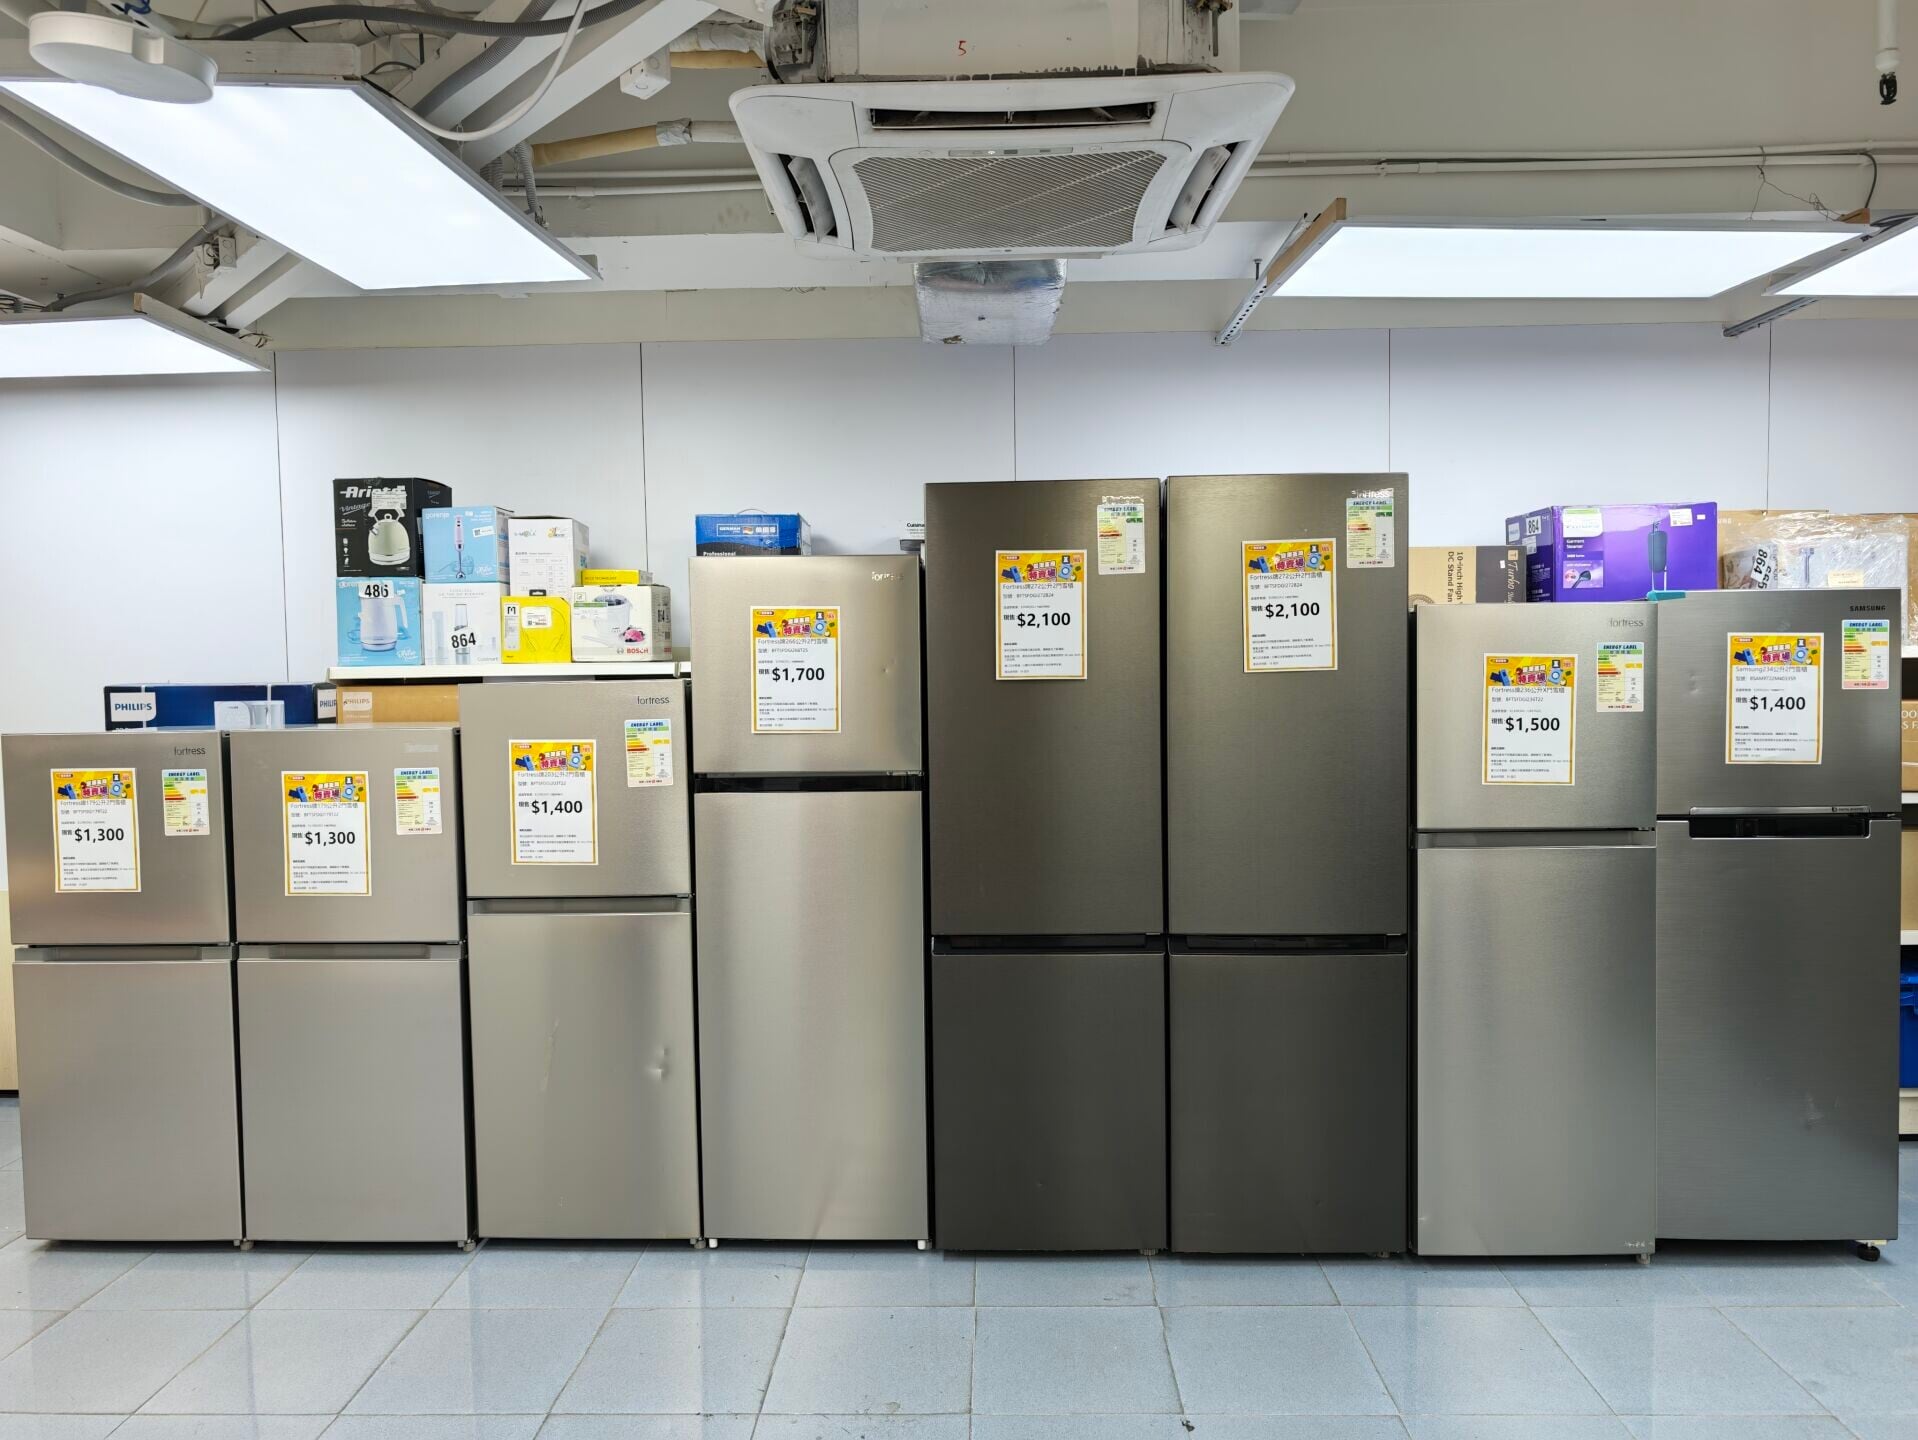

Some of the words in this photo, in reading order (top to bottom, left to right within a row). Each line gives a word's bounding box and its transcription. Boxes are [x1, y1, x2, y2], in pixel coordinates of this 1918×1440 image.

[958, 40, 966, 56] 5
[1528, 518, 1540, 534] 864
[1448, 552, 1454, 562] DC
[1752, 548, 1768, 574] 864
[1456, 552, 1464, 580] 10-inch
[1508, 562, 1520, 590] Turbo
[364, 584, 389, 598] 486
[1455, 582, 1464, 600] High
[1265, 602, 1320, 619] $2,100
[1850, 604, 1886, 612] SAMSUNG
[1017, 612, 1071, 628] $2,100
[1609, 618, 1644, 628] fortress
[451, 632, 476, 648] 864
[772, 667, 825, 682] $1,700
[114, 702, 152, 712] PHILIPS
[637, 696, 670, 705] fortress
[1750, 696, 1806, 712] $1,400
[1505, 717, 1560, 733] $1,500
[174, 746, 206, 756] fortress
[531, 800, 583, 815] $1,400
[74, 828, 124, 844] $1,300
[305, 831, 356, 846] $1,300
